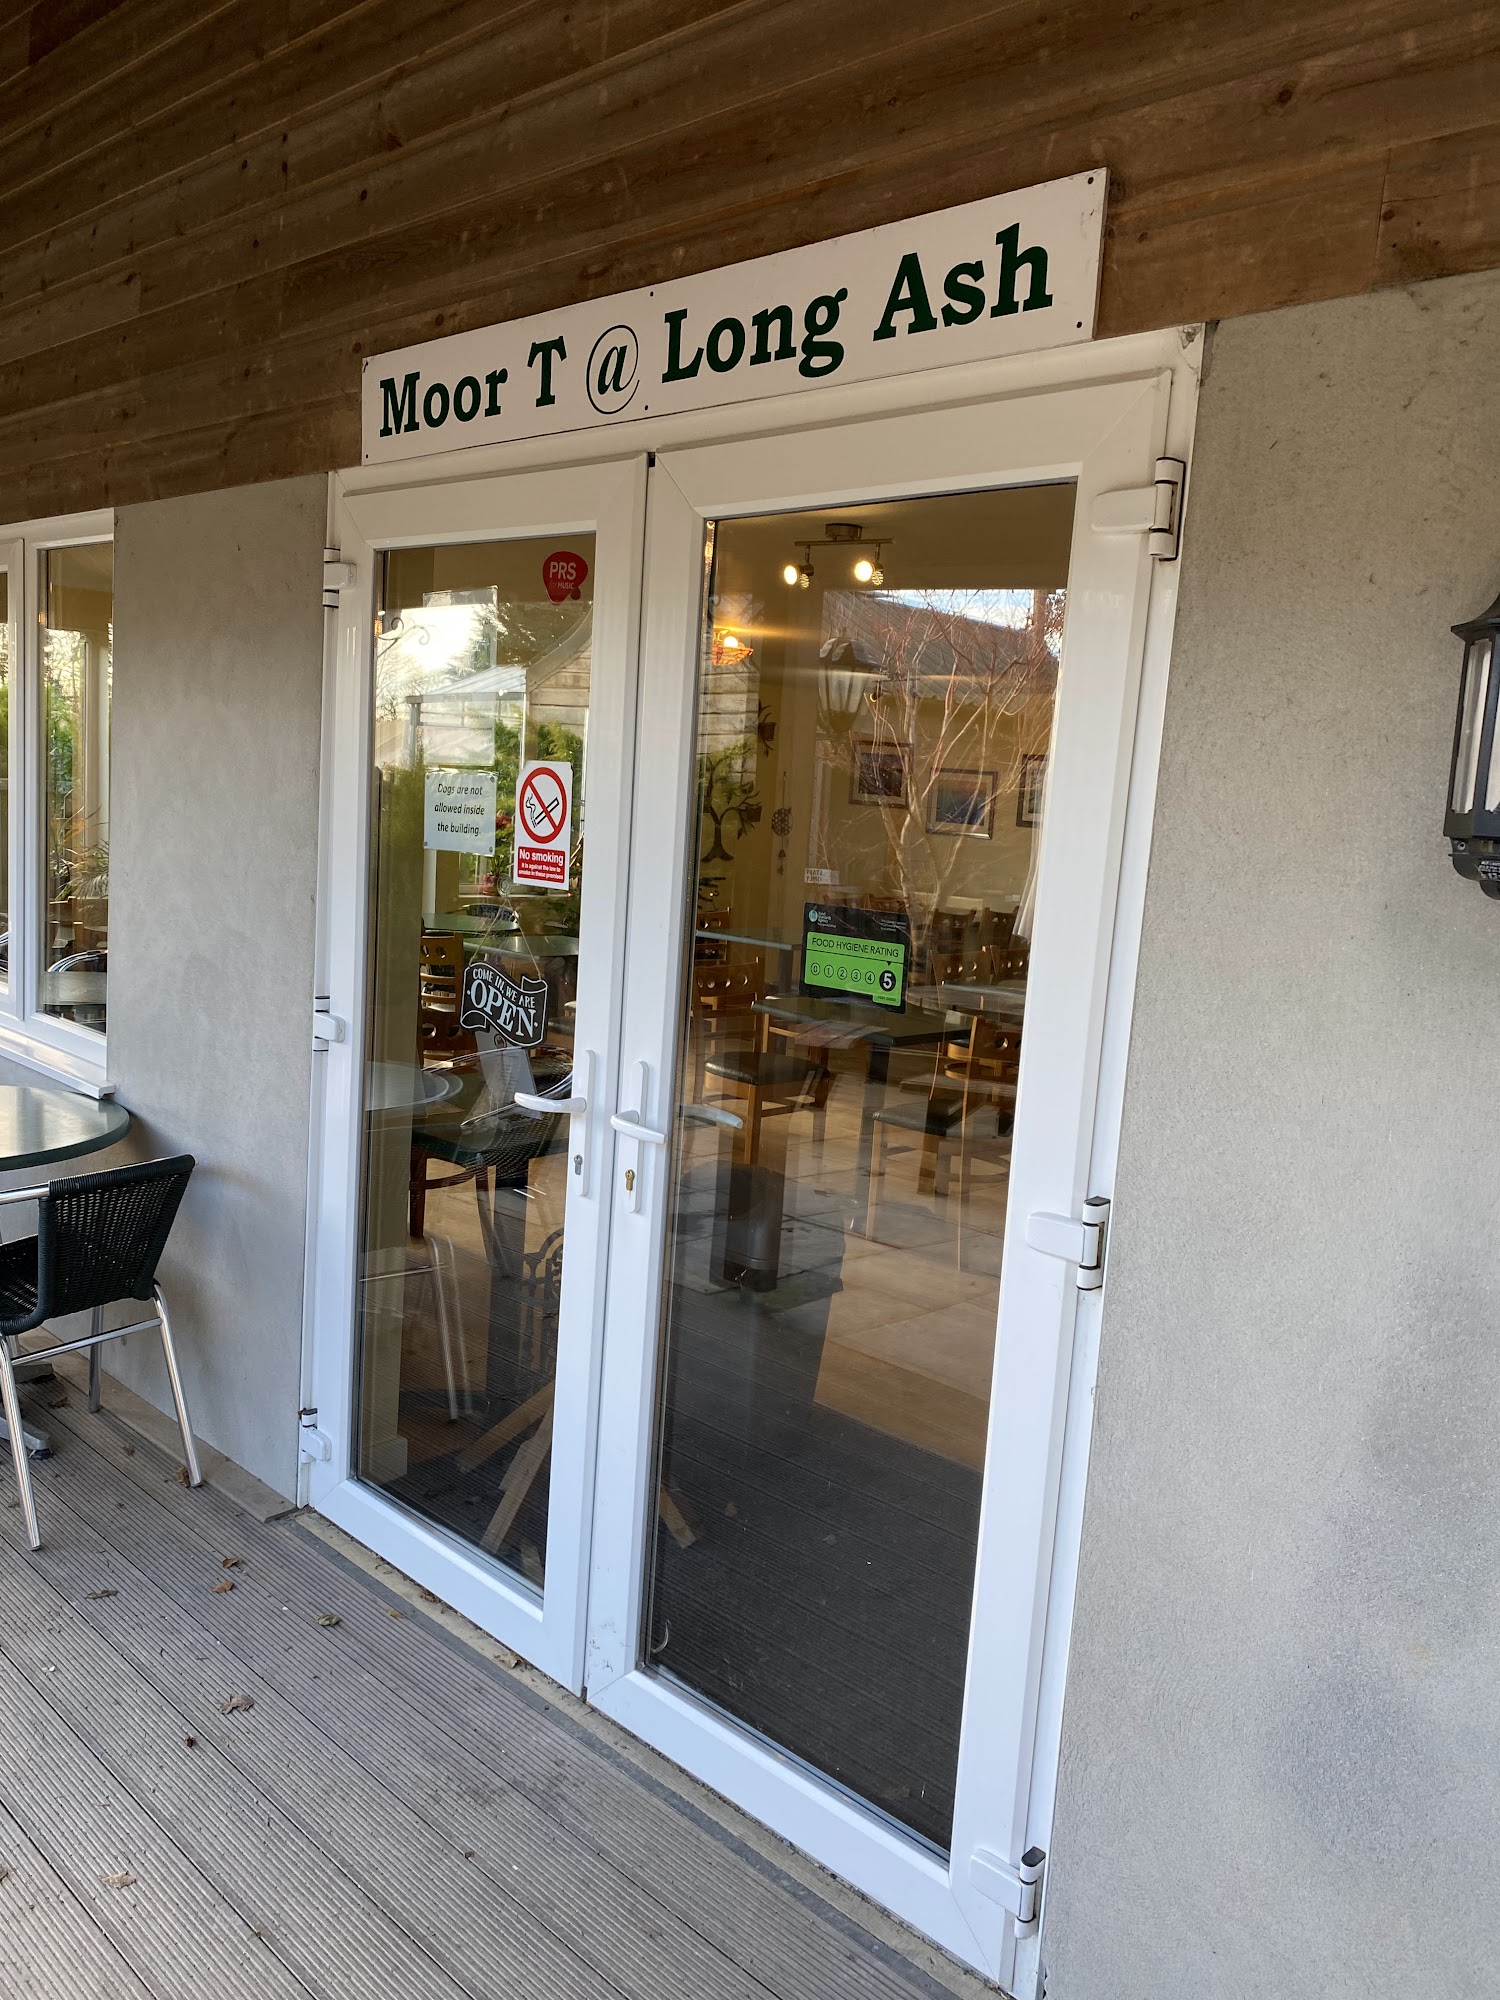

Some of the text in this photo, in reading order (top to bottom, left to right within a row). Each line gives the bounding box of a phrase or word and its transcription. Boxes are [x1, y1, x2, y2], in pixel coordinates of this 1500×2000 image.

[379, 222, 1053, 438] Moor T @ Long Ash
[549, 561, 577, 580] PRS
[557, 582, 575, 590] MUSIC
[437, 783, 483, 796] Dogs are not
[434, 802, 485, 816] allowed inside
[437, 821, 482, 837] the building.
[519, 848, 564, 866] No smoking
[811, 937, 899, 958] FOOD HYGIENE RATING
[472, 968, 494, 983] COME
[505, 985, 518, 1002] WE
[518, 993, 536, 1008] ARE
[882, 972, 892, 989] 5
[470, 979, 537, 1038] OPEN
